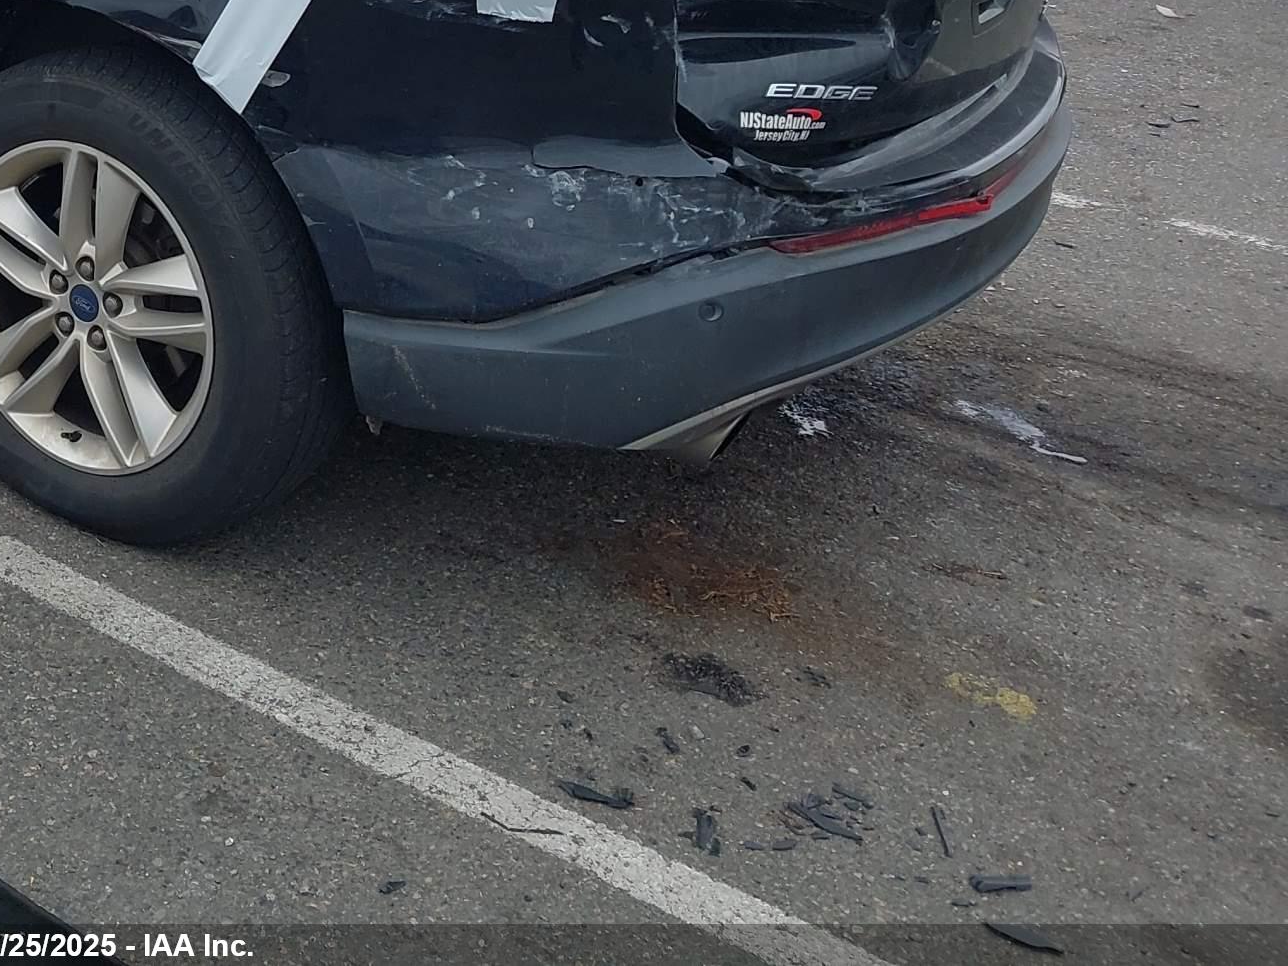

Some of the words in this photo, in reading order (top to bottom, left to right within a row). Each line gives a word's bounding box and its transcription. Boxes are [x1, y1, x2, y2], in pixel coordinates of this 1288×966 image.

[766, 83, 878, 101] EDGE
[740, 112, 826, 130] NJStateAuto.com
[754, 130, 783, 142] Jersey
